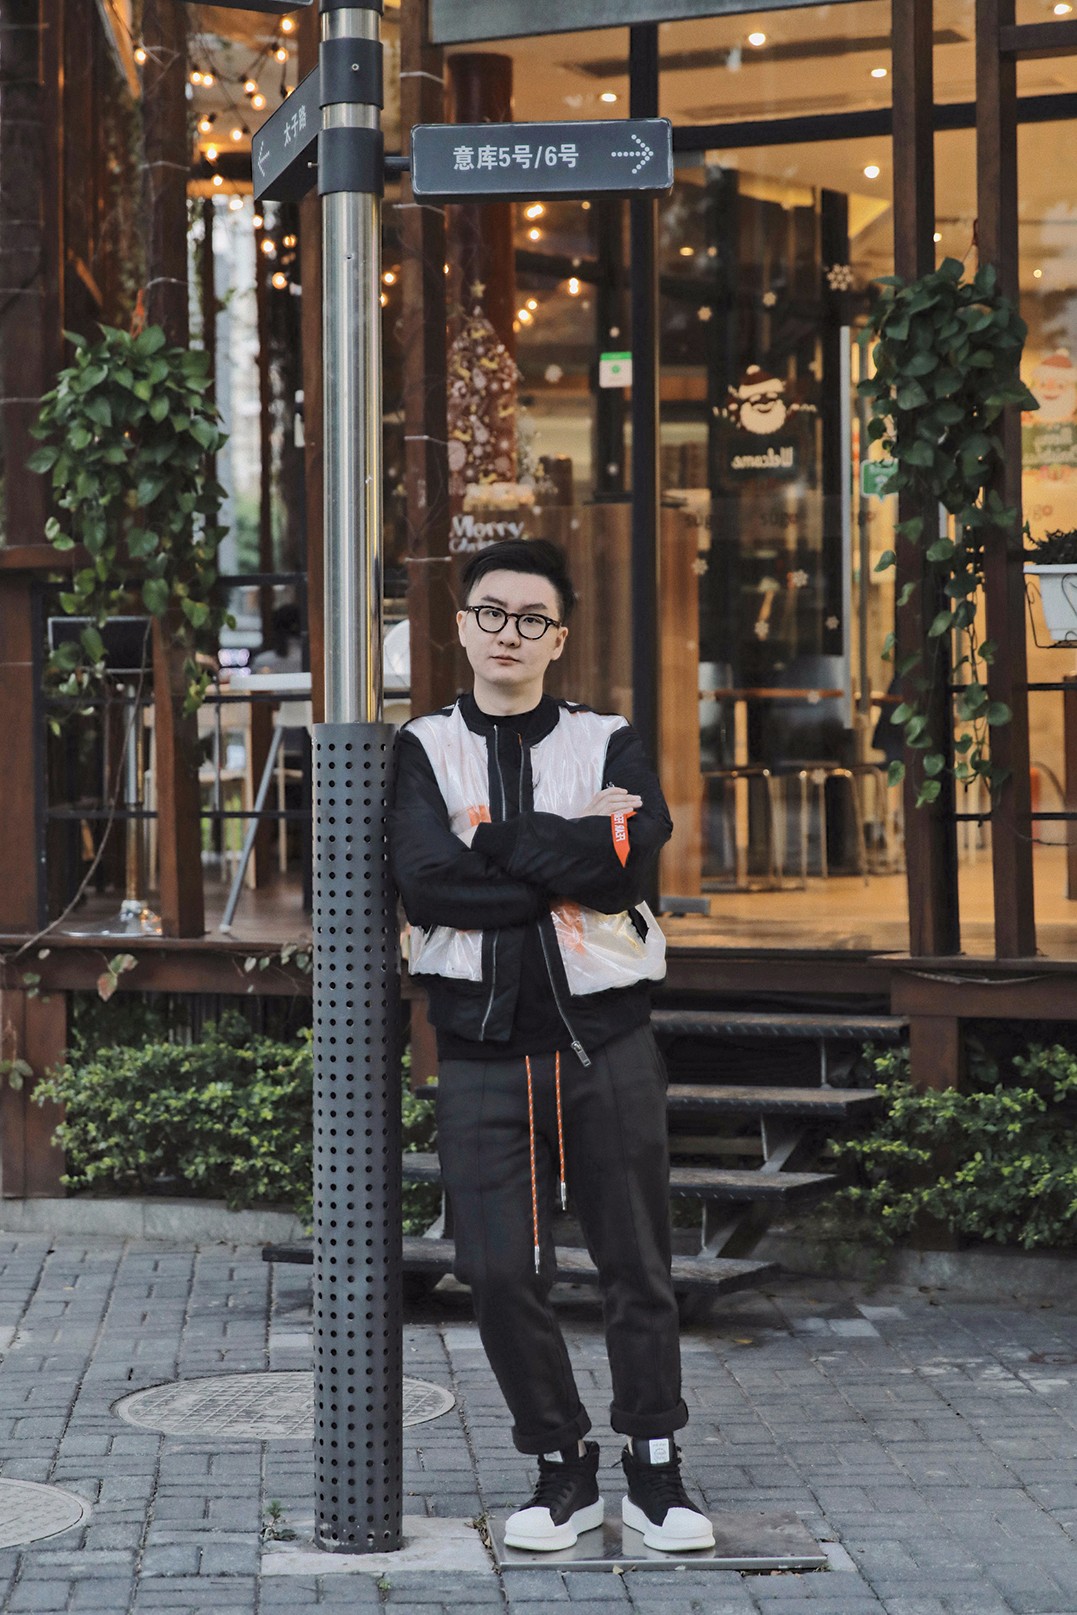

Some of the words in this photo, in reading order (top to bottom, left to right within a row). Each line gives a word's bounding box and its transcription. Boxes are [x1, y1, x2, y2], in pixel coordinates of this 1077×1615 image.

[283, 105, 307, 147] 太子路
[453, 144, 579, 171] 意库5号/6号
